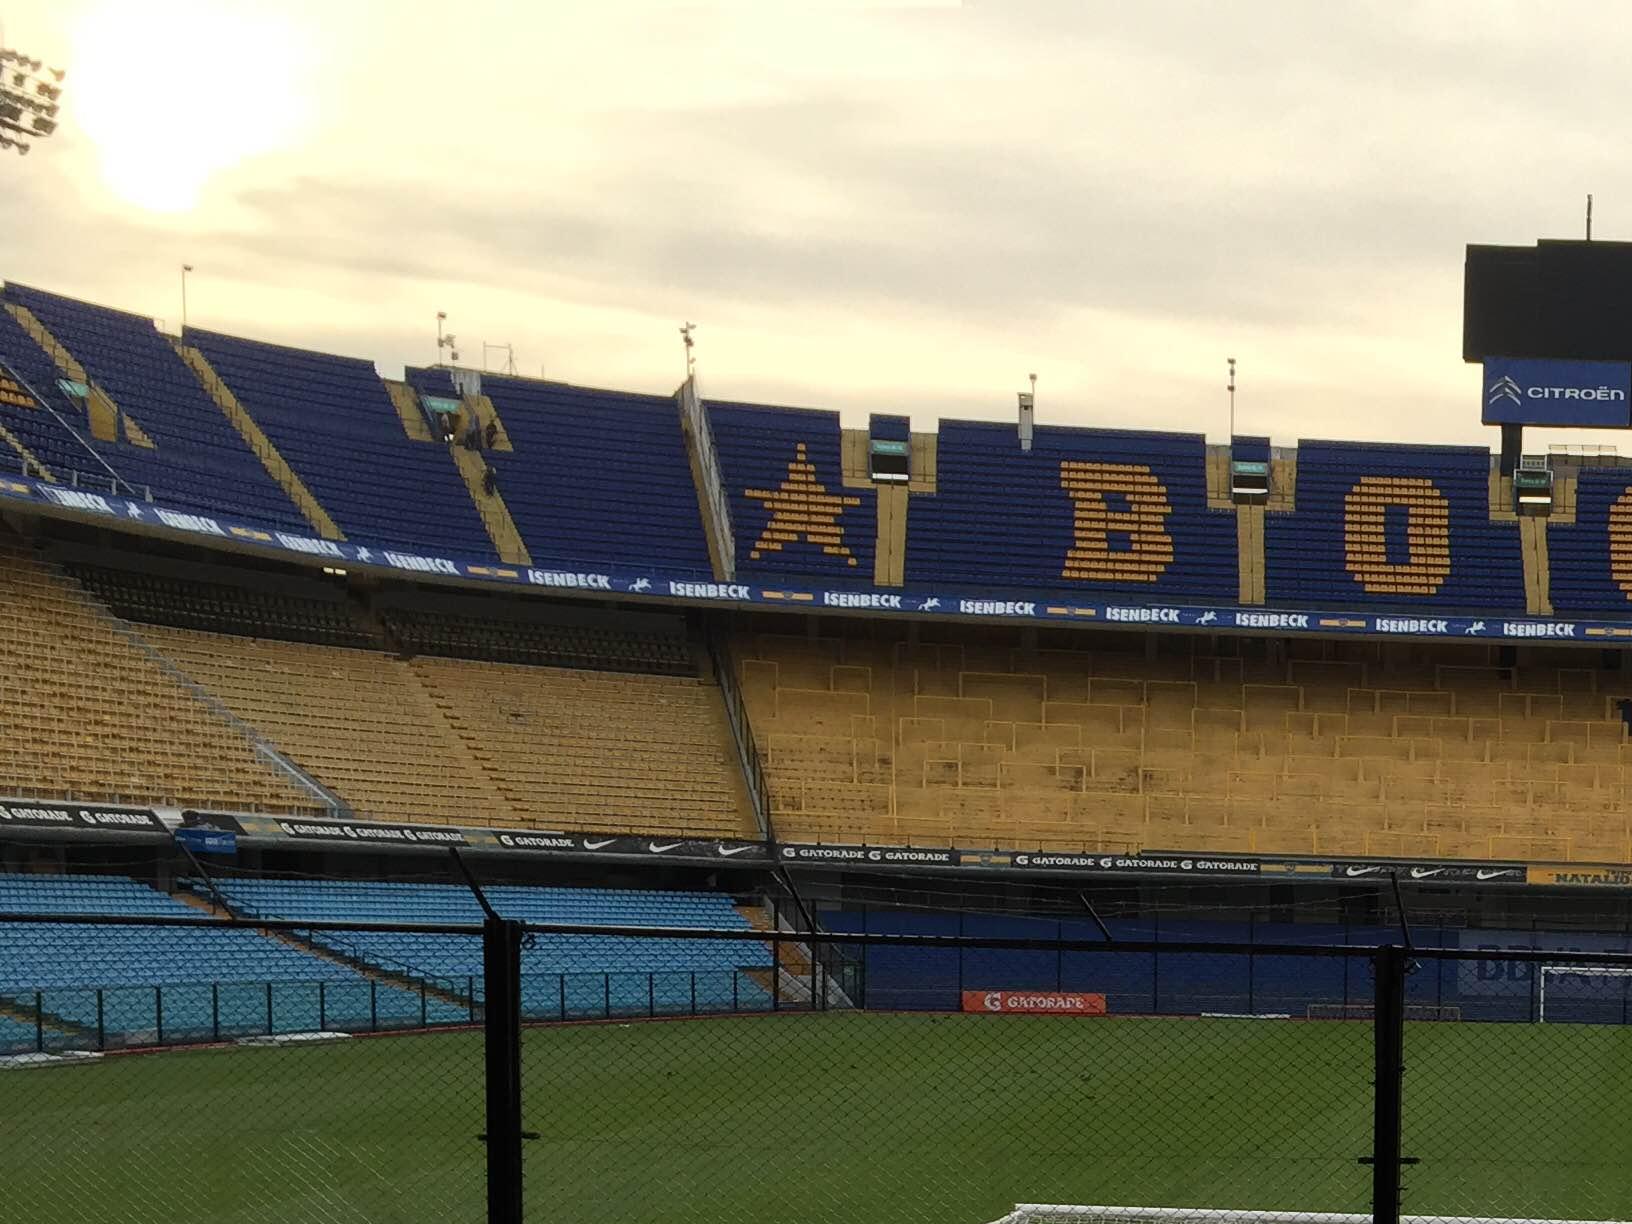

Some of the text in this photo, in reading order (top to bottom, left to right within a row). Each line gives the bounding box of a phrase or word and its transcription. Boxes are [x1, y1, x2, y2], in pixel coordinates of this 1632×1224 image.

[527, 568, 612, 590] ISENBECK
[669, 581, 750, 600] ISENBECK
[823, 591, 902, 609] ISENBECK
[959, 600, 1036, 616] ISENBECK
[1106, 606, 1180, 623] ISENBECK
[1235, 613, 1309, 628] ISENBECK
[1375, 618, 1448, 633] ISENBECK
[1503, 622, 1575, 637] ISENBECK
[515, 836, 575, 848] GATORADE
[800, 848, 865, 859] GATORADE
[885, 851, 949, 862] GATORADE
[1032, 856, 1095, 867] GATORADE
[1116, 858, 1178, 869] GATORADE
[1196, 861, 1258, 871] GATORADE
[1007, 996, 1085, 1009] GATORADE
